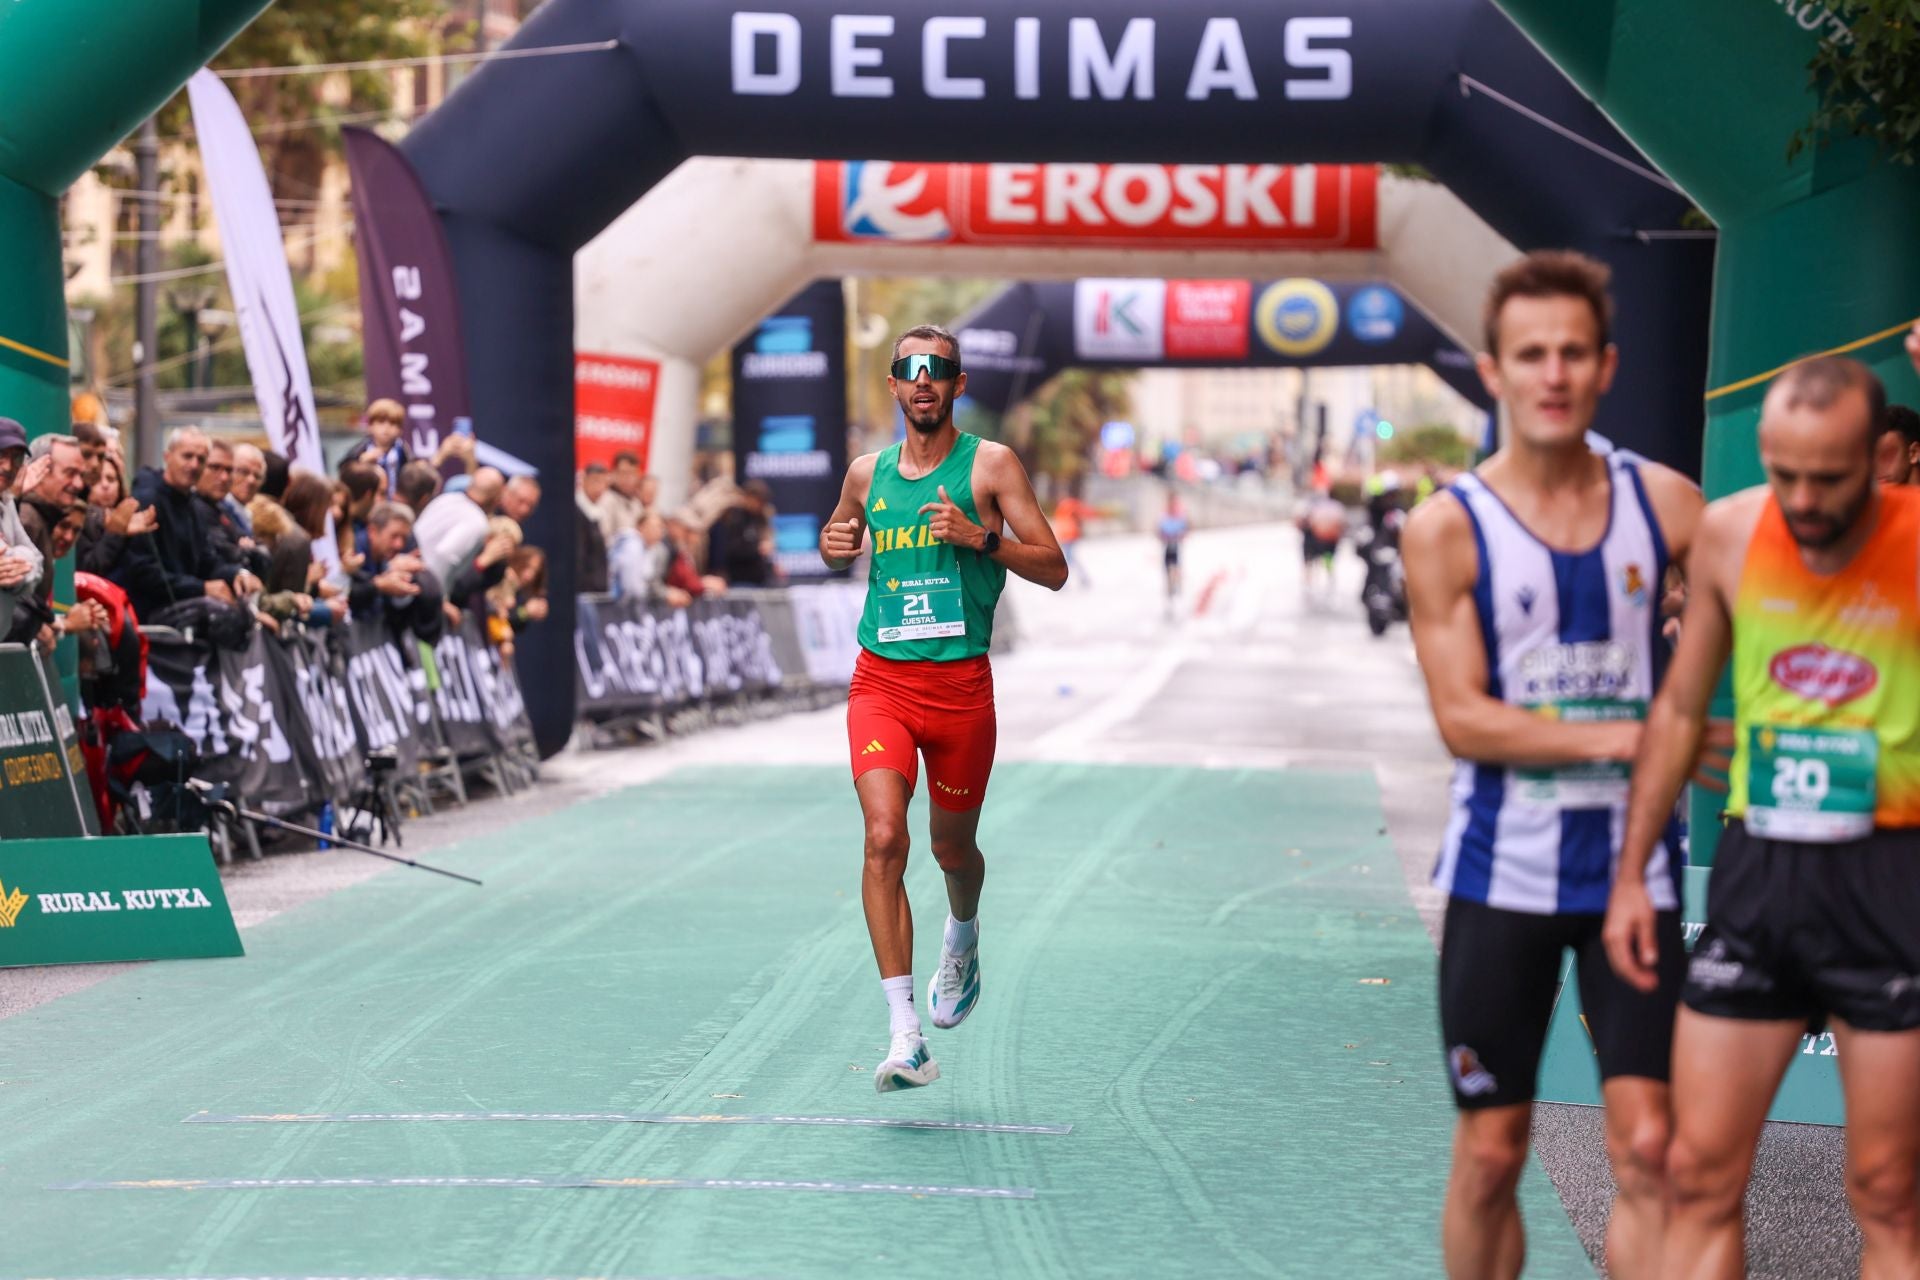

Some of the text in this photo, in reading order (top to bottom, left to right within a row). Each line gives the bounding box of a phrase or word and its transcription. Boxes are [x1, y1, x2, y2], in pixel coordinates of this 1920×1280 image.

[731, 11, 1353, 100] DECIMAS
[986, 164, 1316, 227] EROSKI
[902, 577, 950, 588] RURAL KUTXA
[903, 593, 933, 616] 21
[901, 616, 937, 625] CUESTAS
[1771, 756, 1830, 799] 20
[37, 888, 212, 913] RURAL KUTXA
